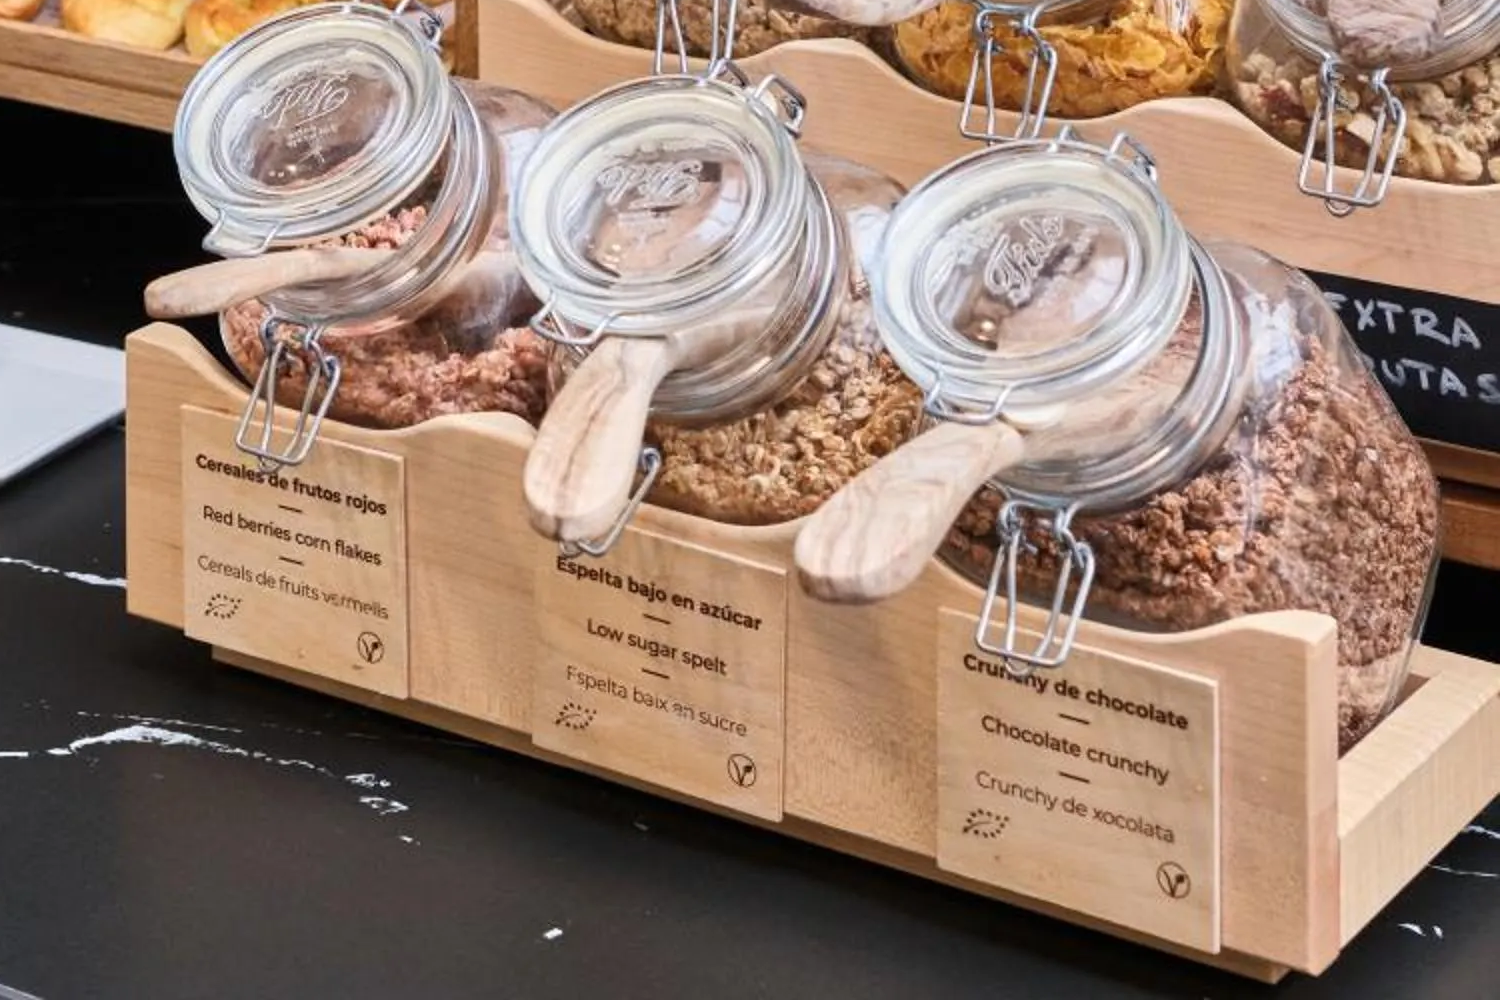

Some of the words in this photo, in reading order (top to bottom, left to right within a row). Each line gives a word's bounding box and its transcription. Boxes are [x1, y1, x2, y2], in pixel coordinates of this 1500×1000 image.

[195, 453, 265, 485] Cereales
[267, 471, 288, 491] de
[293, 476, 342, 504] frutos
[346, 493, 388, 516] rojos
[203, 505, 233, 527] Red
[237, 513, 292, 542] berries
[295, 532, 331, 553] corn
[334, 539, 383, 567] flakes
[197, 555, 253, 583] Cereals
[255, 568, 277, 589] de
[279, 575, 320, 602] fruits
[627, 575, 668, 603] bajo
[671, 592, 695, 612] en
[699, 602, 763, 632] azúcar
[587, 617, 625, 642] Low
[627, 633, 678, 659] sugar
[681, 648, 728, 675] spelt
[632, 685, 670, 713] baix
[672, 701, 697, 722] en
[698, 710, 748, 738] sucre
[1053, 678, 1082, 700] de
[1086, 688, 1189, 731] chocolate
[980, 714, 1082, 758] Chocolate
[1086, 747, 1171, 787] crunchy
[975, 770, 1058, 812] Crunchy
[1061, 796, 1089, 819] de
[1092, 806, 1176, 844] xocolata
